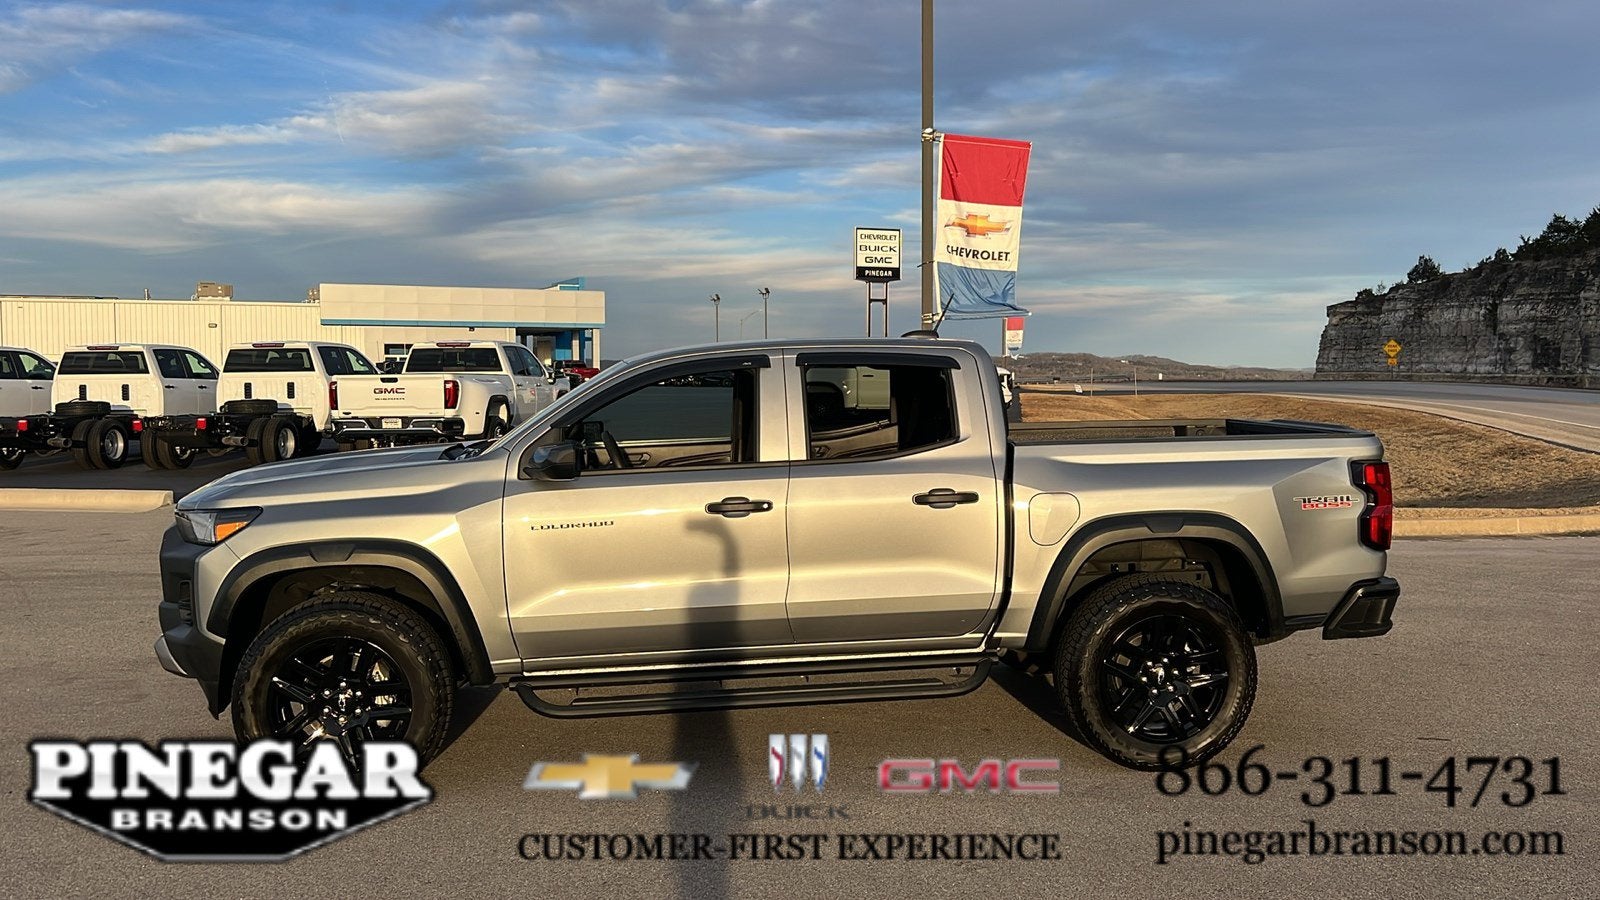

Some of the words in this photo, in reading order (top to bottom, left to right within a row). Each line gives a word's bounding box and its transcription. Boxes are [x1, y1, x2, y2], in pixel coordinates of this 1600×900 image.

[860, 233, 897, 241] CHEVROLET
[859, 245, 897, 253] BUICK
[946, 245, 1011, 262] CHEVROLET
[864, 256, 892, 264] GMC
[865, 269, 892, 277] PINEGAR
[1293, 495, 1359, 504] TRAIL
[1302, 502, 1352, 510] BOSS
[531, 520, 614, 531] COLORADO
